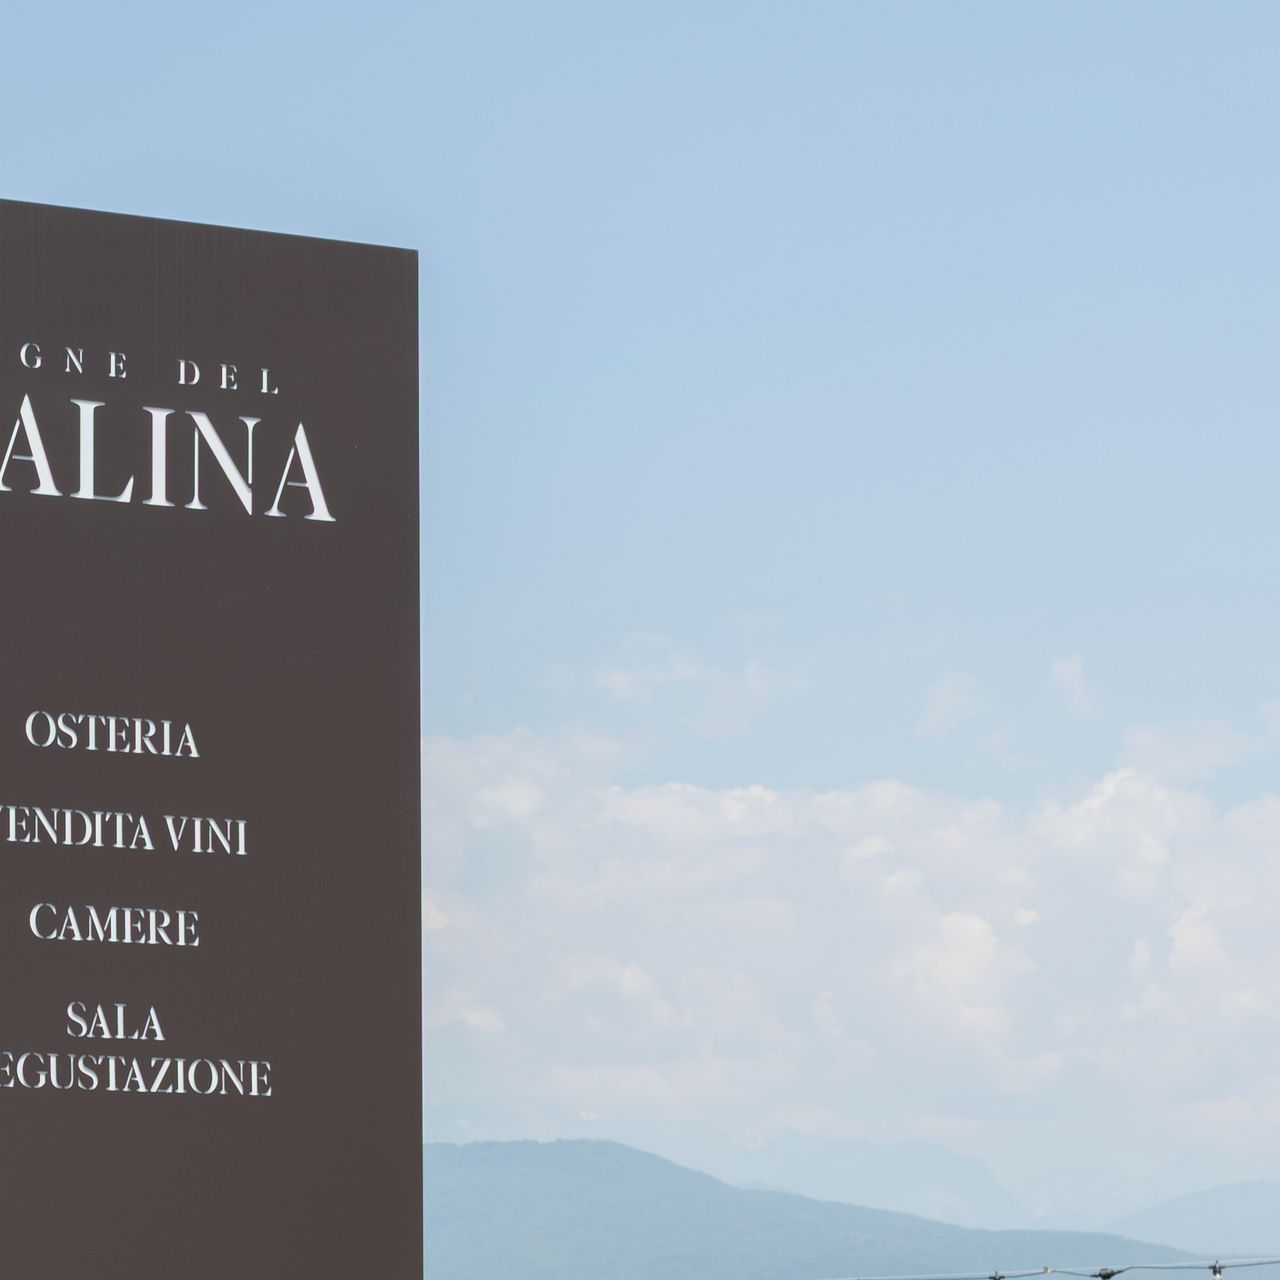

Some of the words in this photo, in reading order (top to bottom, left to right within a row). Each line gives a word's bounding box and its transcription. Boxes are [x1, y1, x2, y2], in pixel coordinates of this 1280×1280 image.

[178, 359, 279, 395] DEL
[25, 710, 200, 758] OSTERIA
[163, 815, 248, 856] VINI
[29, 902, 200, 947] CAMERE
[66, 1001, 166, 1041] SALA
